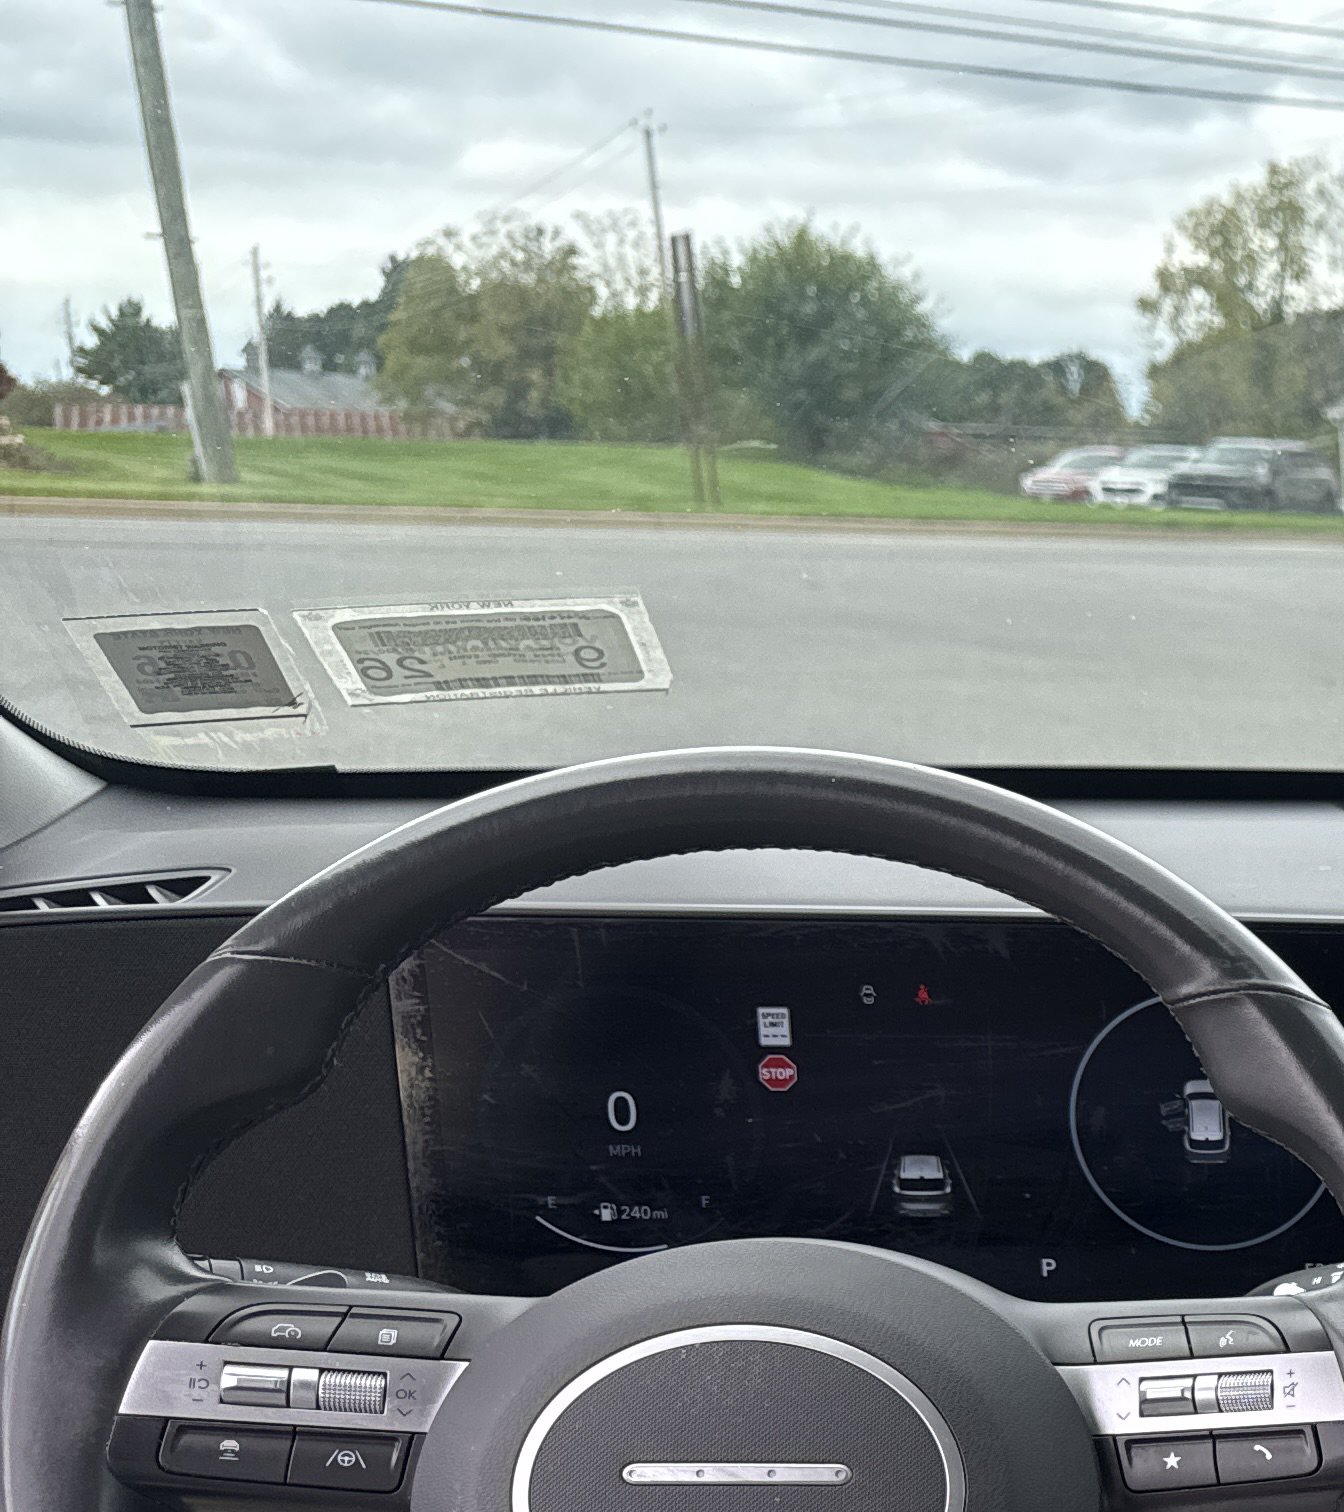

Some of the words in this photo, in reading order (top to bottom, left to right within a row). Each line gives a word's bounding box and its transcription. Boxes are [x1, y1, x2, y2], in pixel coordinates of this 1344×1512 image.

[761, 1012, 787, 1020] SPEED
[763, 1021, 785, 1029] LIMIT
[761, 1067, 795, 1080] STOP
[607, 1091, 637, 1132] 0
[608, 1144, 642, 1158] MPH
[547, 1196, 557, 1209] E
[701, 1195, 711, 1209] F
[620, 1206, 651, 1220] 240
[653, 1208, 669, 1220] mi
[1041, 1258, 1057, 1277] P
[1128, 1336, 1164, 1348] MODE
[395, 1389, 418, 1402] OK
